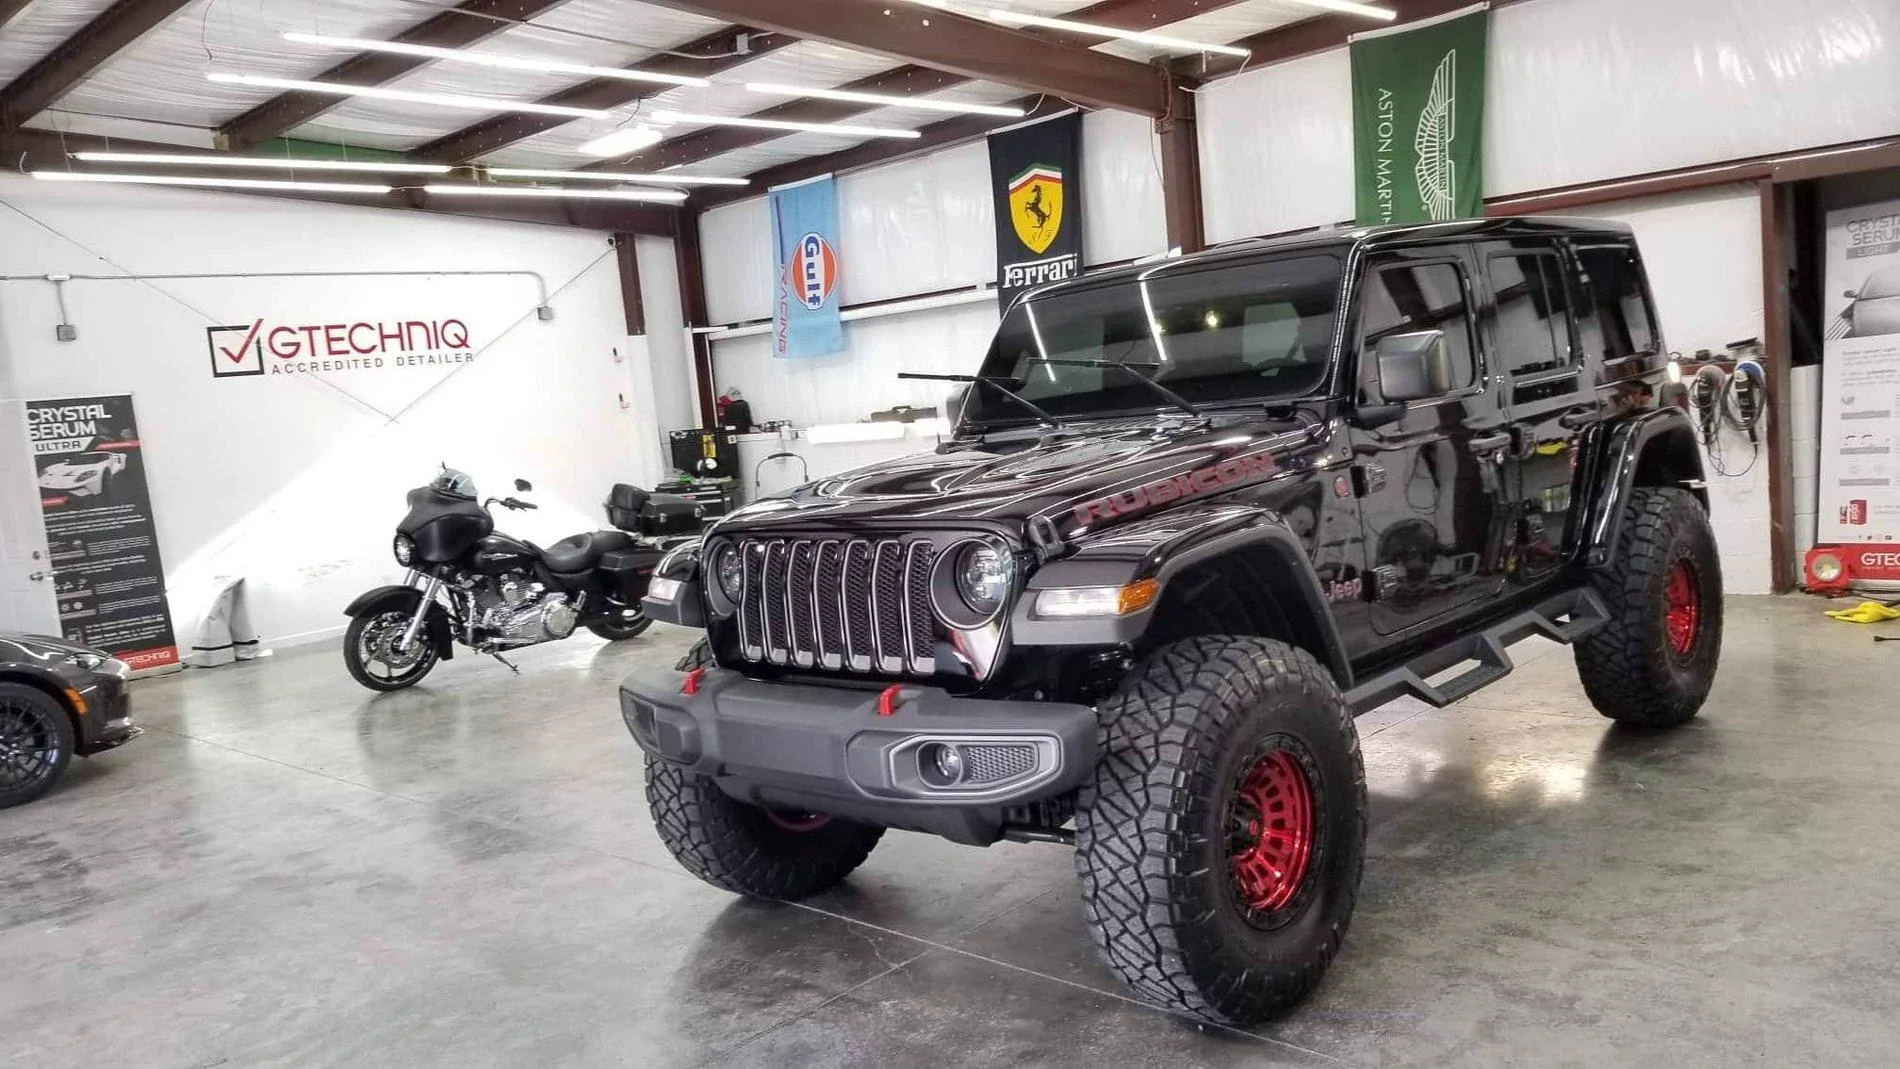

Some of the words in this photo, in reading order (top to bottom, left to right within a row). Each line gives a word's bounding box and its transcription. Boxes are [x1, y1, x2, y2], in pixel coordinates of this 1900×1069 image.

[1377, 88, 1393, 152] ASTON
[1847, 214, 1900, 233] CRYST
[805, 236, 820, 305] Gulf
[1002, 253, 1078, 288] Ferrari
[778, 264, 788, 354] RACING
[268, 319, 471, 359] GTECHNIQ
[272, 359, 384, 375] ACCREDITED
[397, 352, 474, 367] DETAILER
[28, 404, 113, 424] CRYSTAL
[29, 420, 97, 440] SERUM
[35, 440, 82, 452] ULTRA
[1073, 452, 1279, 525] RUBICON
[1326, 577, 1362, 602] Jeep
[124, 650, 171, 664] TECHNIQ
